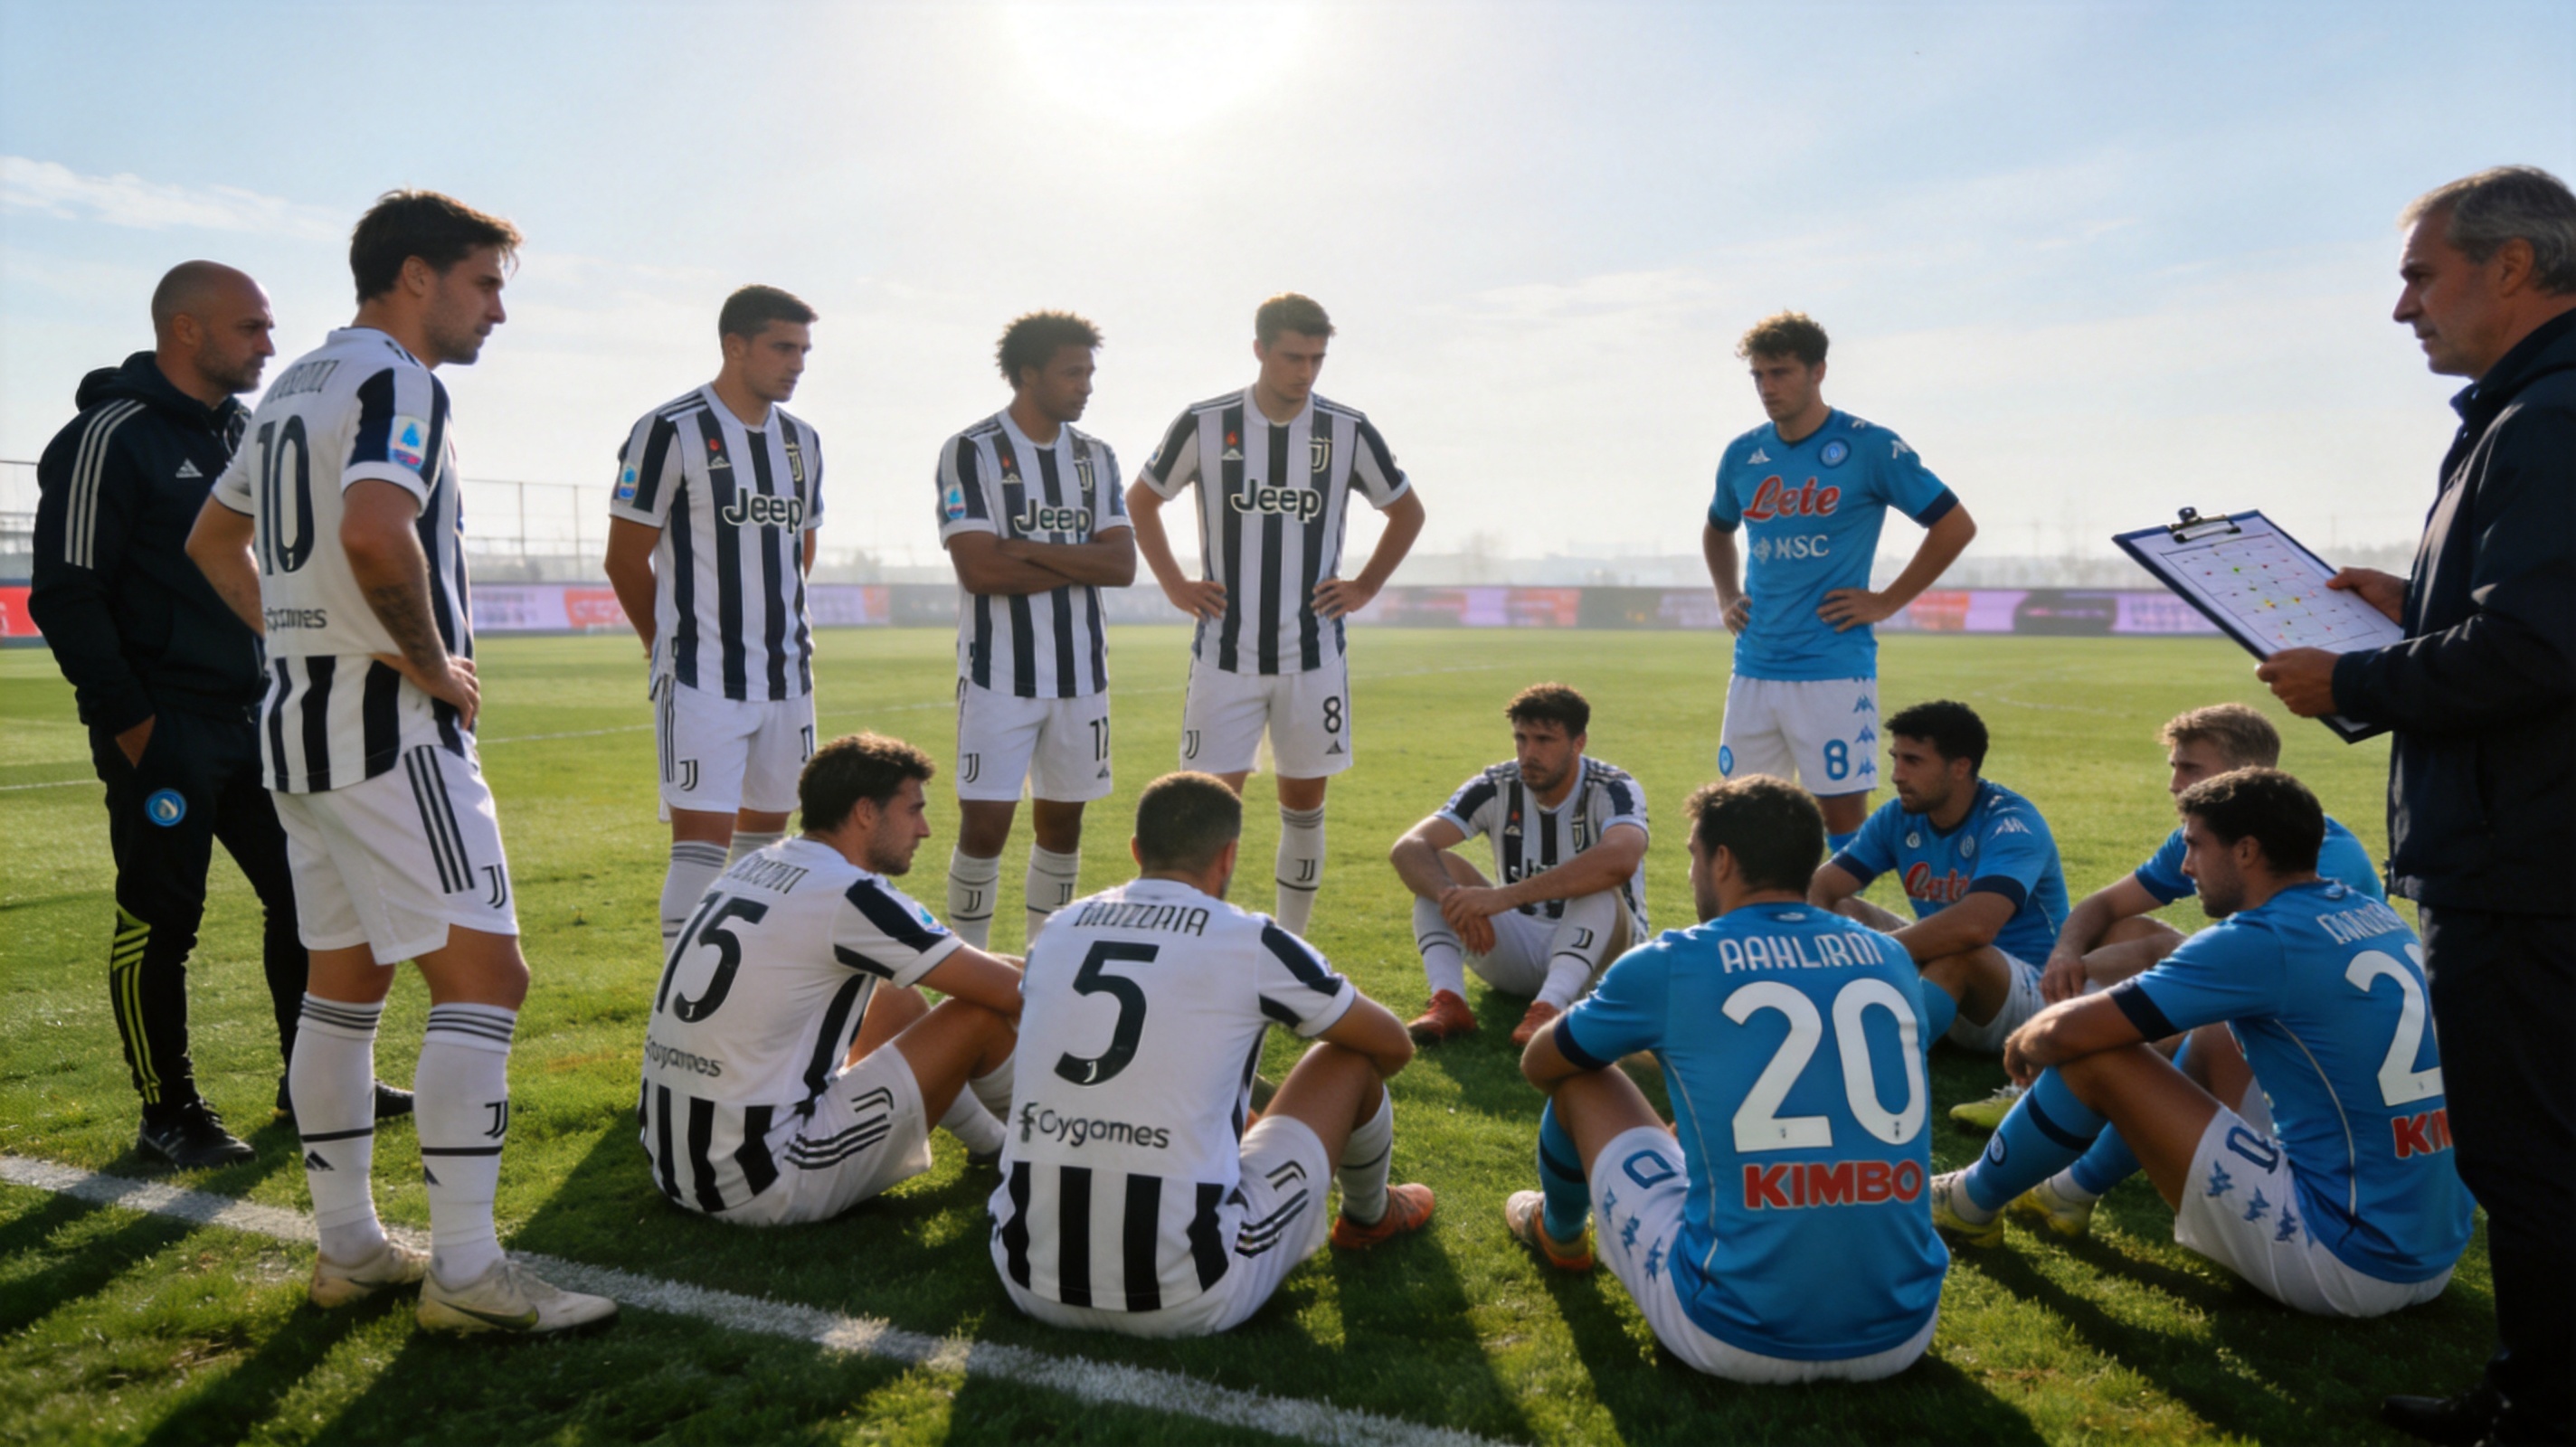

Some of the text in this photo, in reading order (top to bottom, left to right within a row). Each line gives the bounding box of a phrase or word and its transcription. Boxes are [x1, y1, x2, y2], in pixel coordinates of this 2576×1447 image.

[257, 415, 315, 575] 10
[722, 486, 804, 534] Jeep
[1230, 478, 1321, 524] Jeep
[1741, 475, 1842, 522] Lete
[1013, 497, 1093, 544] Jeep
[1323, 695, 1342, 734] 8
[1823, 738, 1850, 781] 8
[656, 891, 770, 1024] 15
[1054, 940, 1160, 1086] 5
[1720, 978, 1927, 1153] 20
[1742, 1159, 1924, 1210] KIMBO
